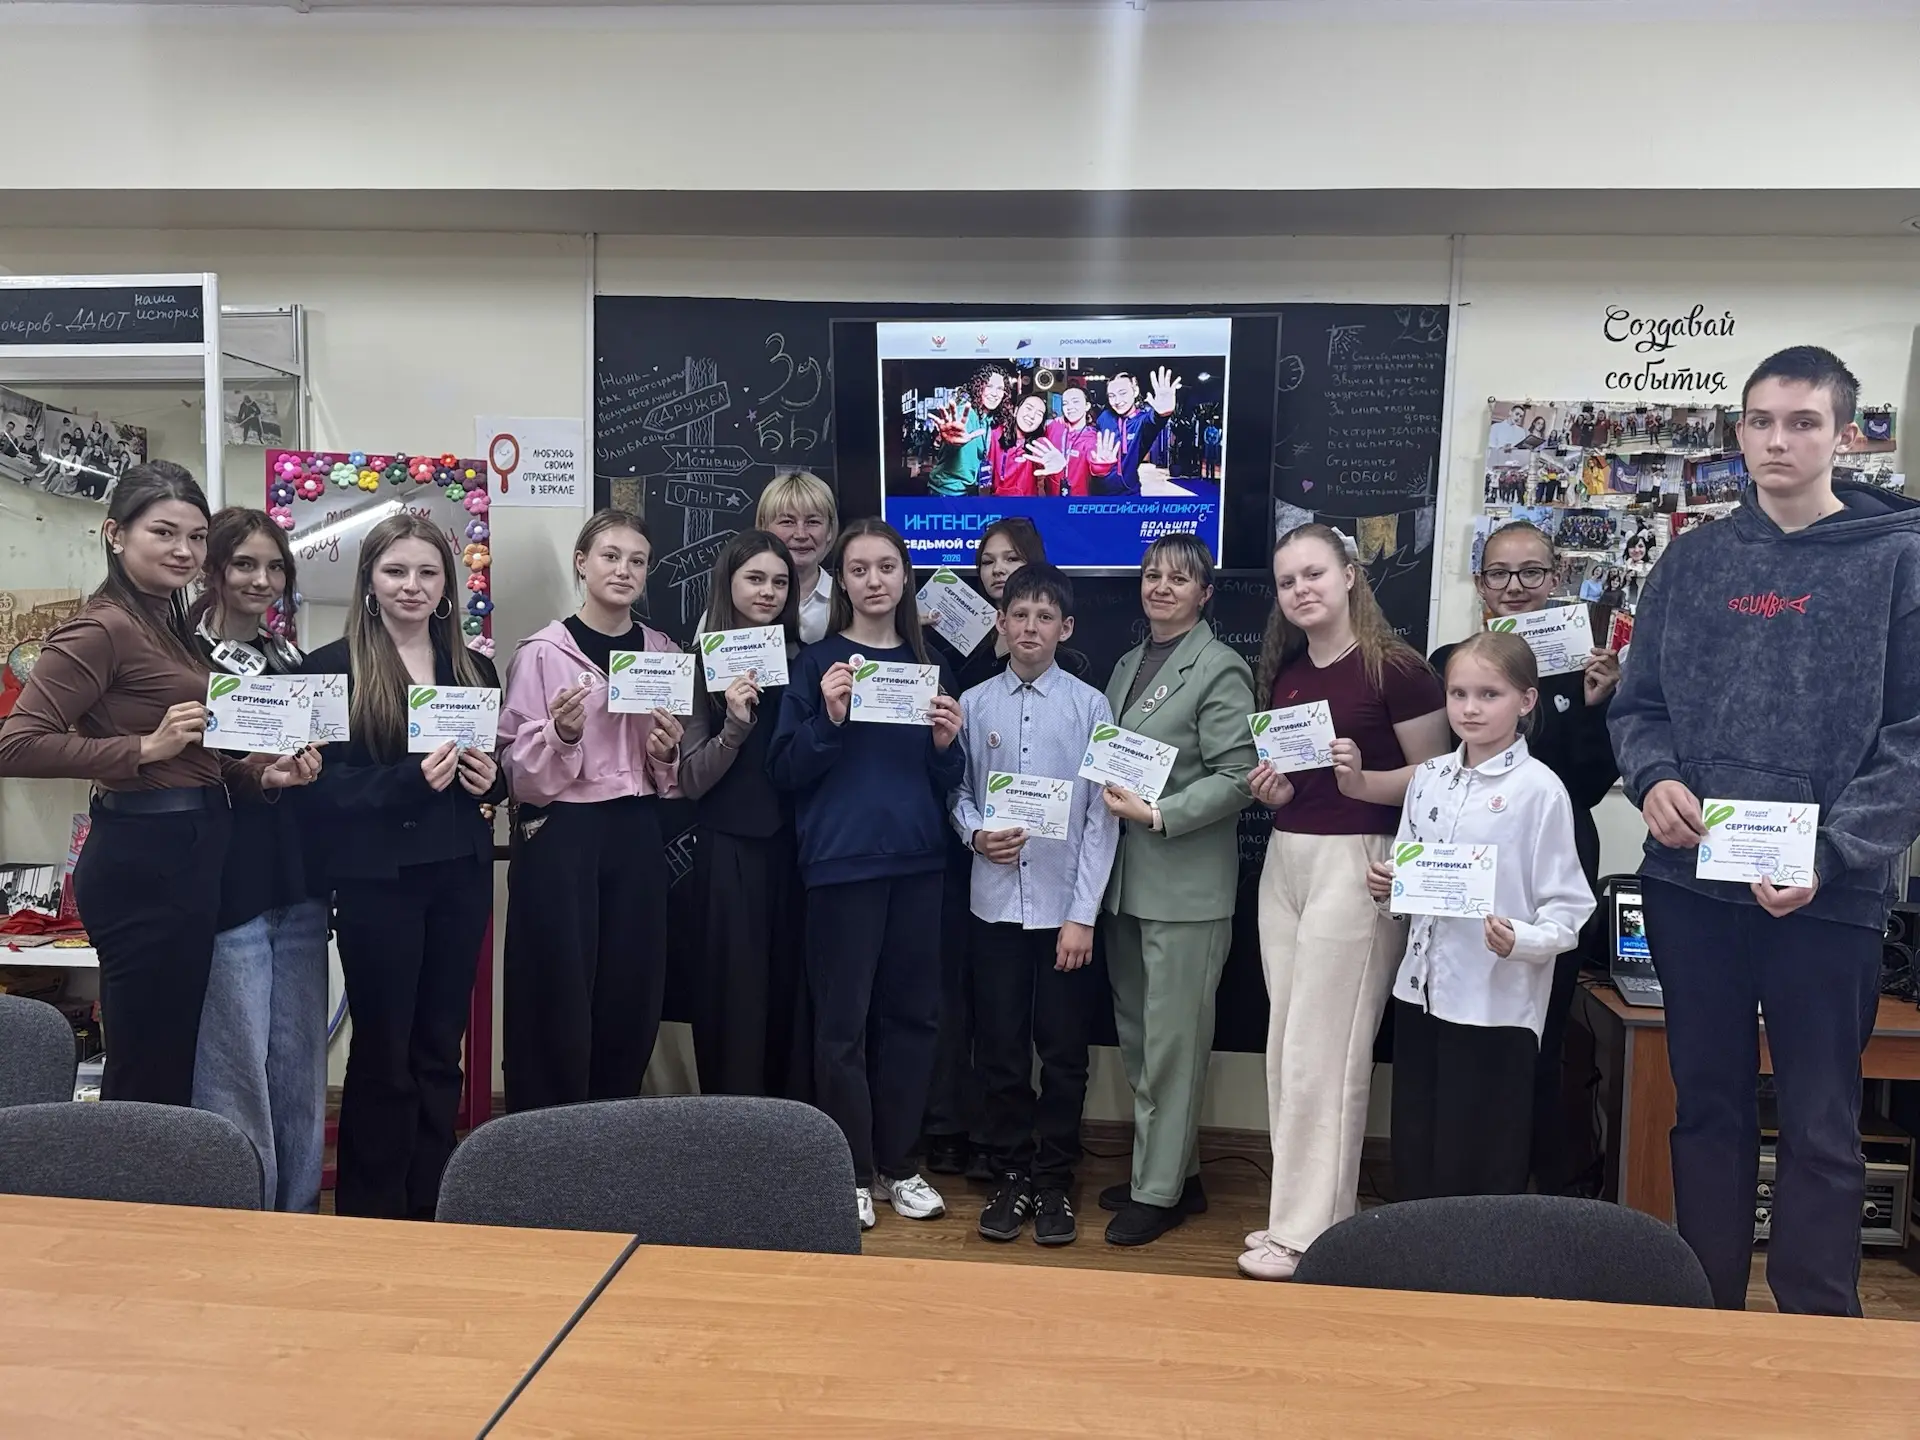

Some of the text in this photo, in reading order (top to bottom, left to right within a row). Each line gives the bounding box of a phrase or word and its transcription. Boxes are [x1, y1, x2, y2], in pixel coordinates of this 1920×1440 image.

[135, 293, 177, 306] наша
[136, 306, 200, 328] история
[0, 312, 53, 338] онеров
[1603, 303, 1735, 353] Создавай
[1605, 358, 1728, 394] события
[532, 448, 574, 458] ЛЮБУЮСЬ
[544, 460, 574, 470] СВОИМ
[522, 472, 575, 482] ОТРАЖЕНИЕМ
[531, 484, 575, 495] В ЗЕРКАЛЕ
[1068, 501, 1215, 514] ВСЕРОССИЙСКИЙ КОНКУРС
[1141, 521, 1198, 529] БОЛЬШАЯ
[679, 540, 729, 574] МЕЧТ
[1516, 624, 1566, 637] ЕРТИФИКАТ
[720, 643, 766, 653] СЕРТИФИКАТ
[629, 668, 676, 676] СЕРТИФИКАТ
[872, 676, 919, 685] СЕРТИФИКАТ
[231, 694, 290, 707] СЕРТИФИКАТ
[1269, 720, 1312, 733] СЕРТИФИКАТ
[1108, 741, 1154, 761] СЕРТИФИКАТ
[1005, 788, 1052, 799] СЕРТИФИКАТ
[1725, 823, 1788, 833] СЕРТИФИКАТ
[1415, 860, 1473, 870] СЕРТИФИКАТ
